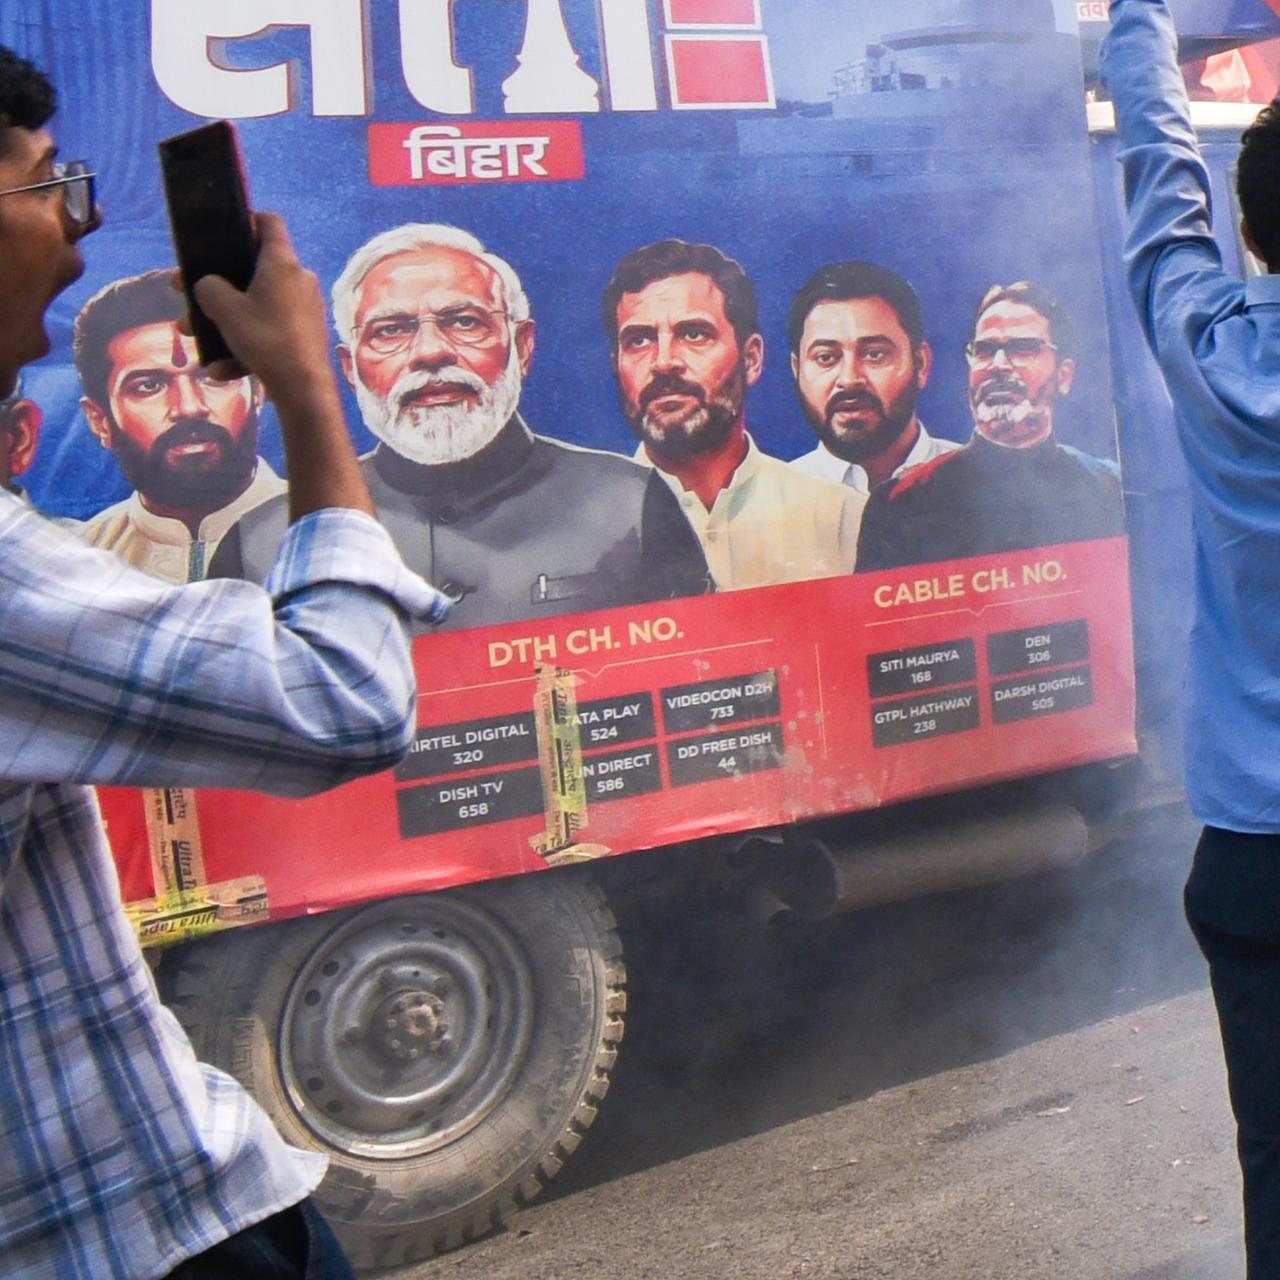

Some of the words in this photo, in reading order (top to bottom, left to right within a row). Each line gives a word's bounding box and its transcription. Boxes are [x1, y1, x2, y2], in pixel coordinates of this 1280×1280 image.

[403, 127, 550, 180] बिहार
[873, 574, 966, 609] CABLE
[971, 567, 1016, 592] CH.
[1022, 560, 1068, 587] NO.
[488, 634, 557, 668] DTH
[565, 627, 621, 655] CH.
[629, 617, 685, 646] NO.
[1024, 635, 1051, 649] DEN
[880, 658, 904, 673] SITI
[906, 649, 960, 669] MAURYA
[666, 686, 742, 711] VIDEOCON
[744, 681, 773, 698] D2H
[994, 684, 1037, 703] DARSH
[1038, 676, 1085, 694] DIGITAL
[603, 703, 641, 721] PLAY
[709, 705, 735, 720] 733
[874, 709, 907, 725] GTPL
[909, 696, 973, 718] HATHWAY
[465, 723, 529, 745] DIGITAL
[590, 726, 619, 742] 524
[677, 744, 699, 759] DD
[701, 739, 738, 756] FREE
[739, 731, 772, 749] DISH
[452, 749, 484, 766] 320
[598, 753, 653, 775] DIRECT
[439, 784, 480, 804] DISH
[481, 780, 504, 797] TV
[596, 777, 625, 793] 586
[458, 802, 489, 819] 658
